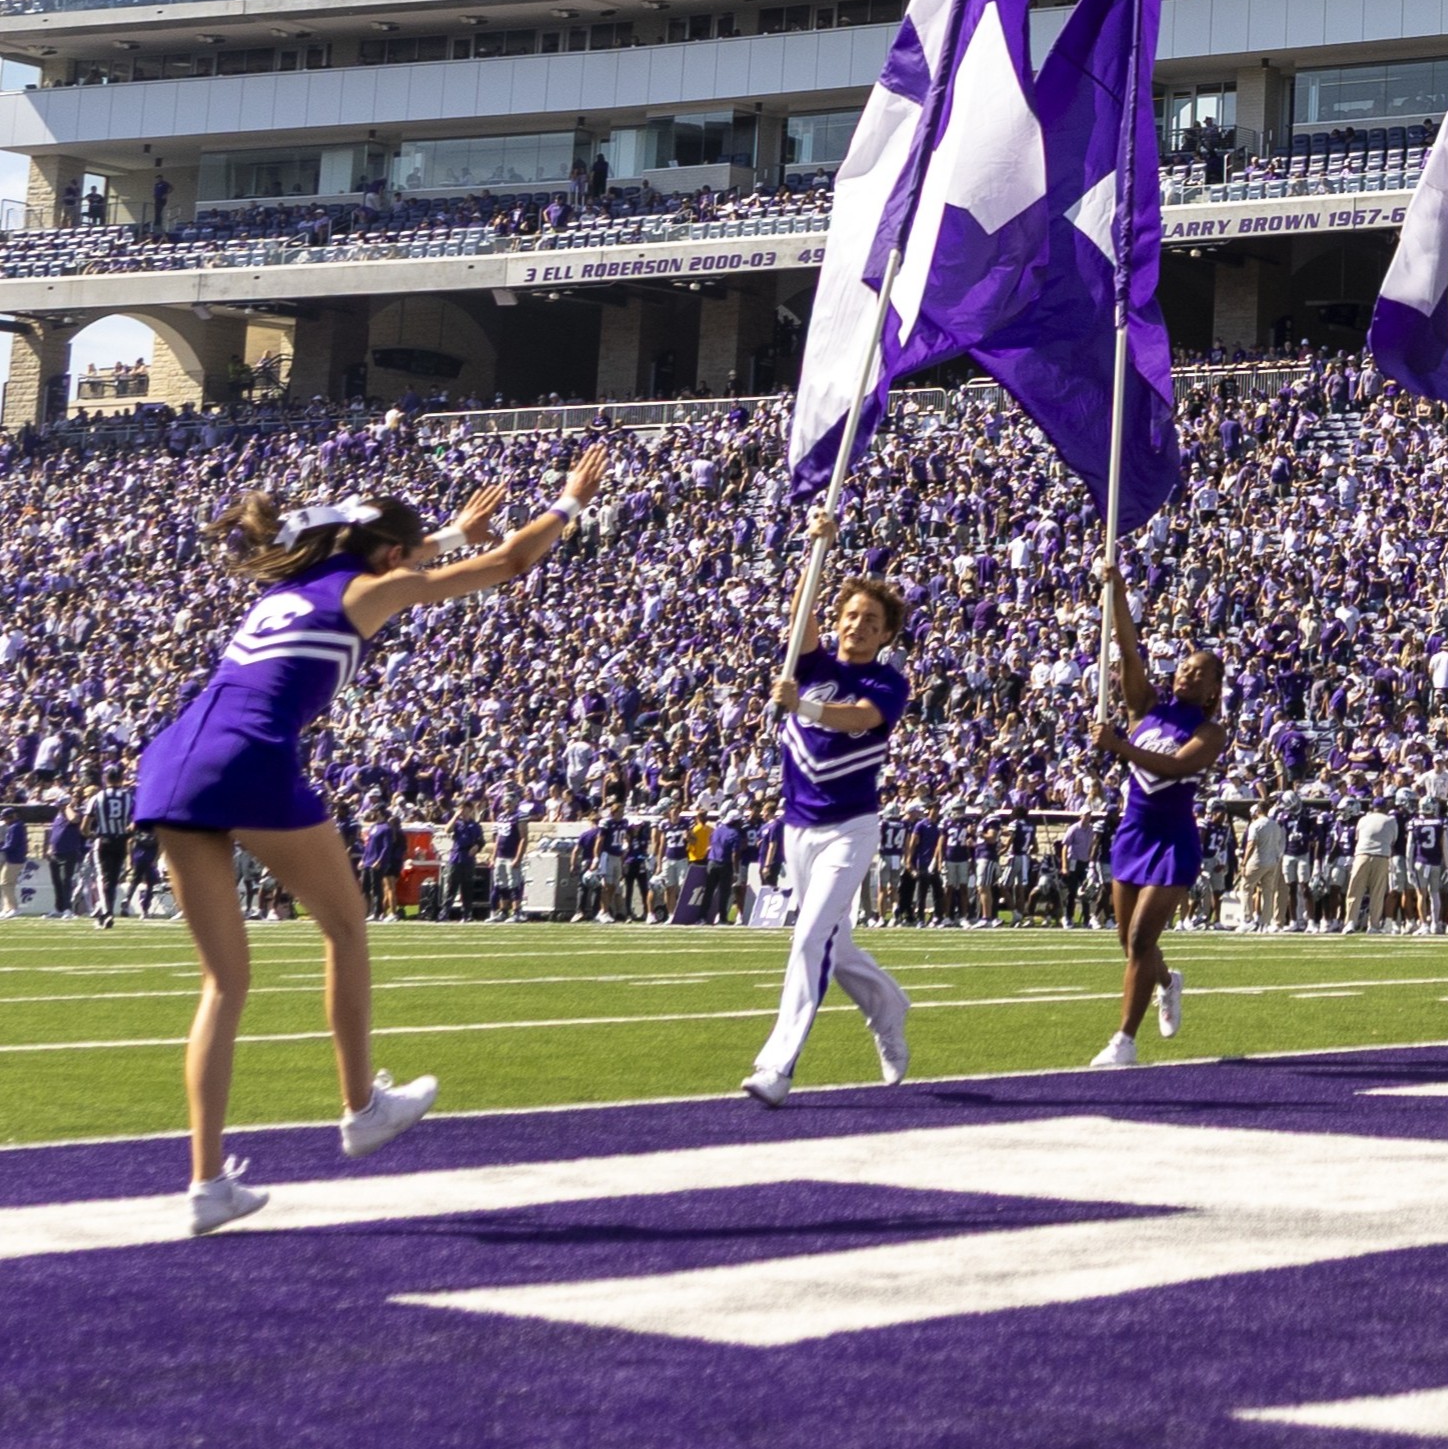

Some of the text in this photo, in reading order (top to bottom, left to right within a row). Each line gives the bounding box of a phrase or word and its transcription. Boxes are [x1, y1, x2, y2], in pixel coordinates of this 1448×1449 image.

[1161, 207, 1407, 238] LARRY BROWN 1967-6
[524, 251, 776, 283] 3 ELL ROBERSON 2000-03
[797, 247, 826, 264] 49
[108, 798, 122, 818] B
[666, 830, 686, 848] 27
[885, 827, 908, 850] 14
[947, 827, 968, 847] 24
[1421, 826, 1436, 849] 3
[759, 894, 785, 919] 12
